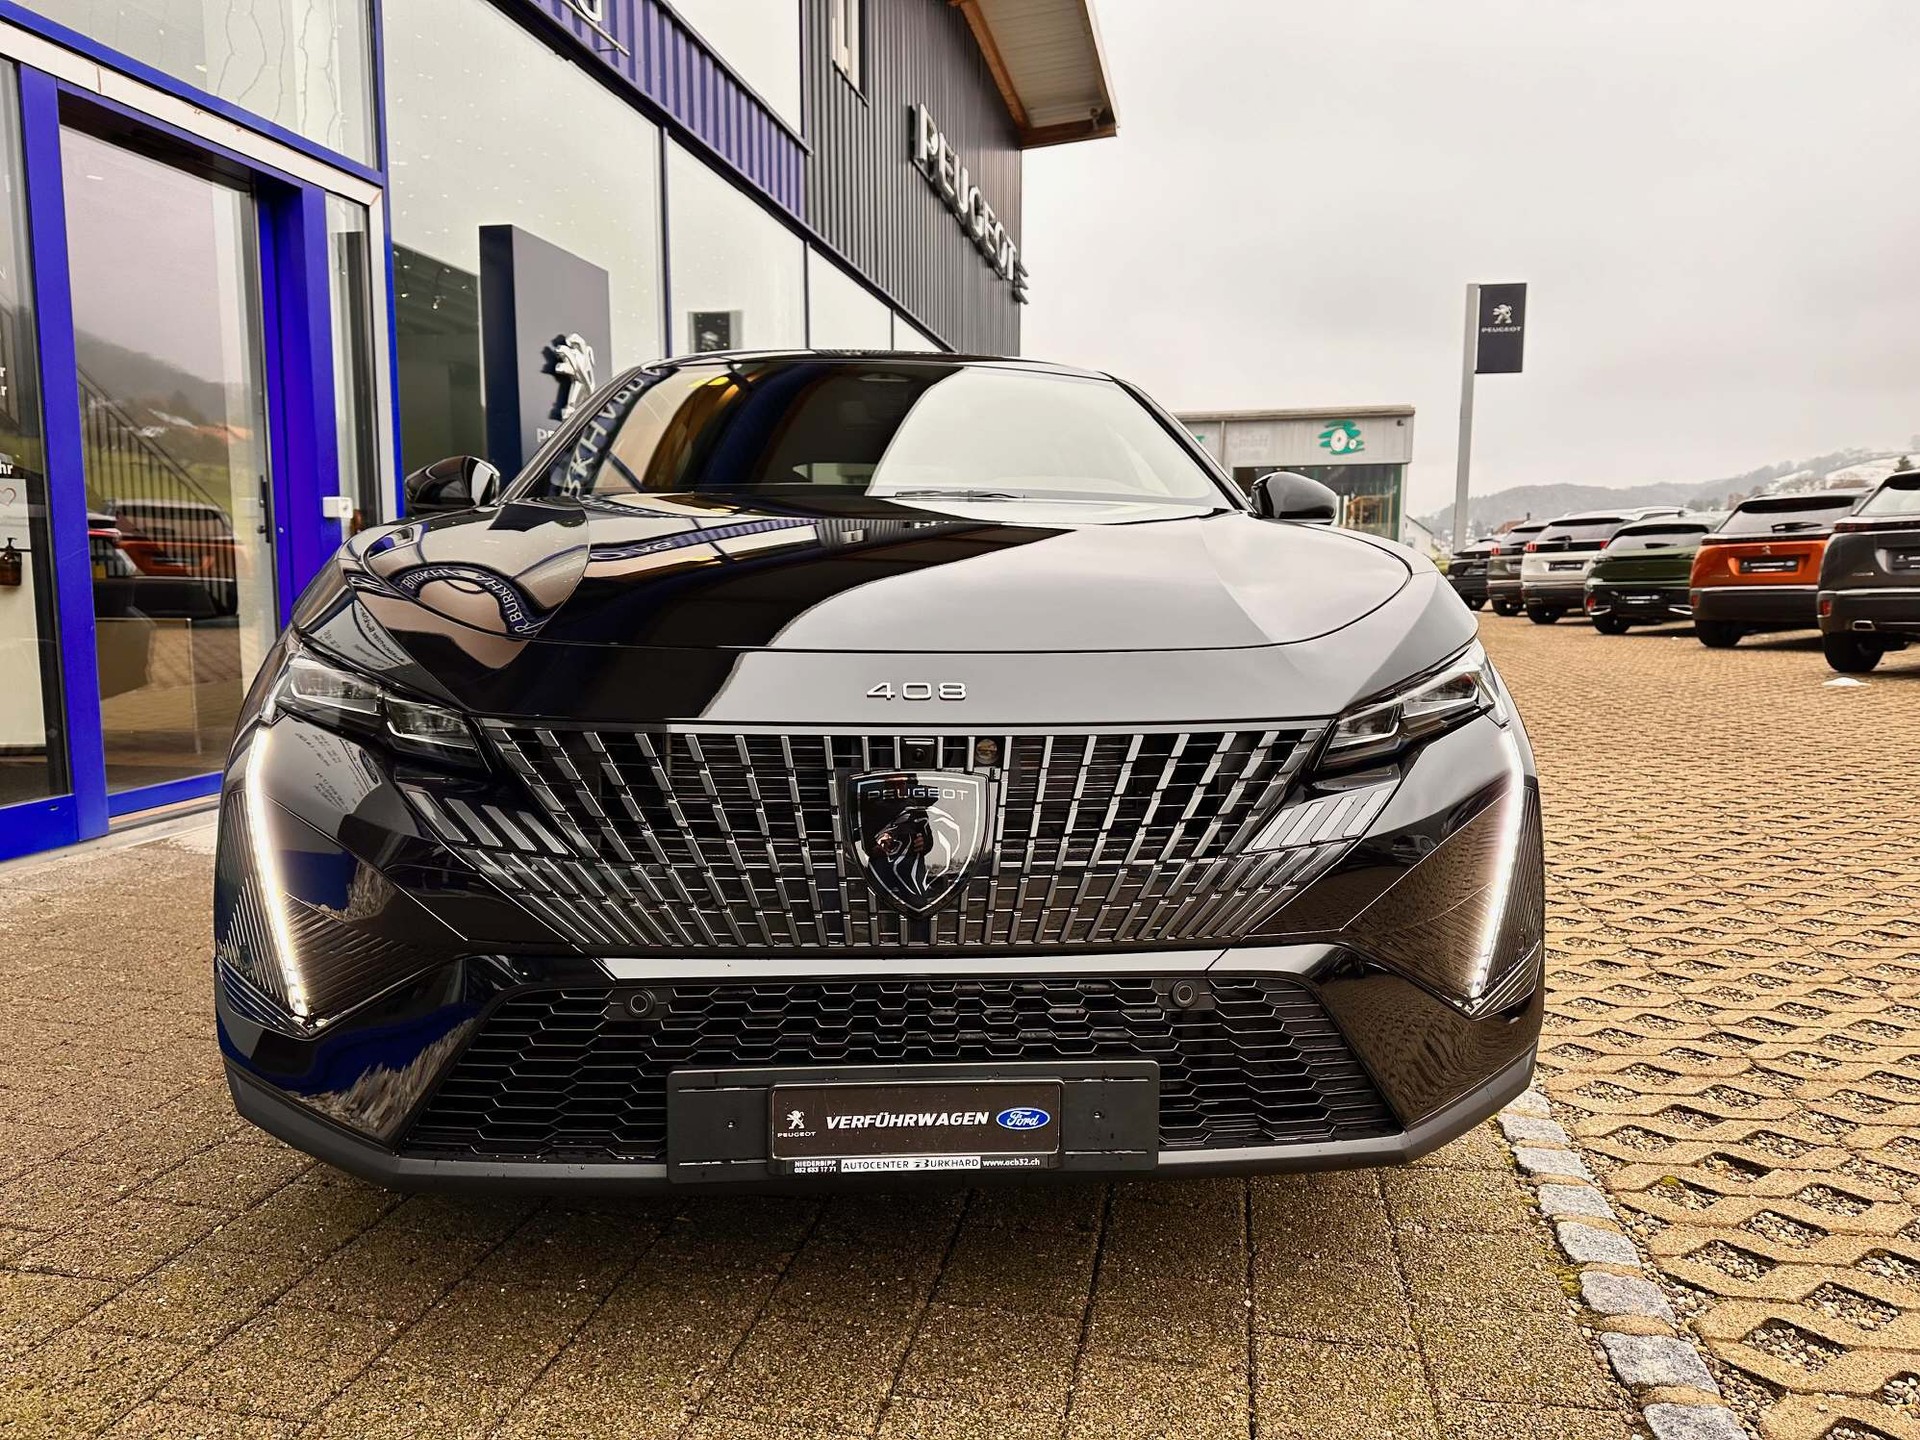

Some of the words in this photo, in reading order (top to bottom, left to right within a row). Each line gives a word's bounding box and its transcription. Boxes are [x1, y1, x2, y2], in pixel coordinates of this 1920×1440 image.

[918, 102, 1017, 281] PEUGEOT
[866, 682, 968, 700] 408
[867, 788, 969, 800] PEUGEOT
[826, 1111, 990, 1130] VERFÜHRWAGEN
[843, 1160, 909, 1170] AUTOCENTER
[982, 1157, 1041, 1167] www.acb32.ch
